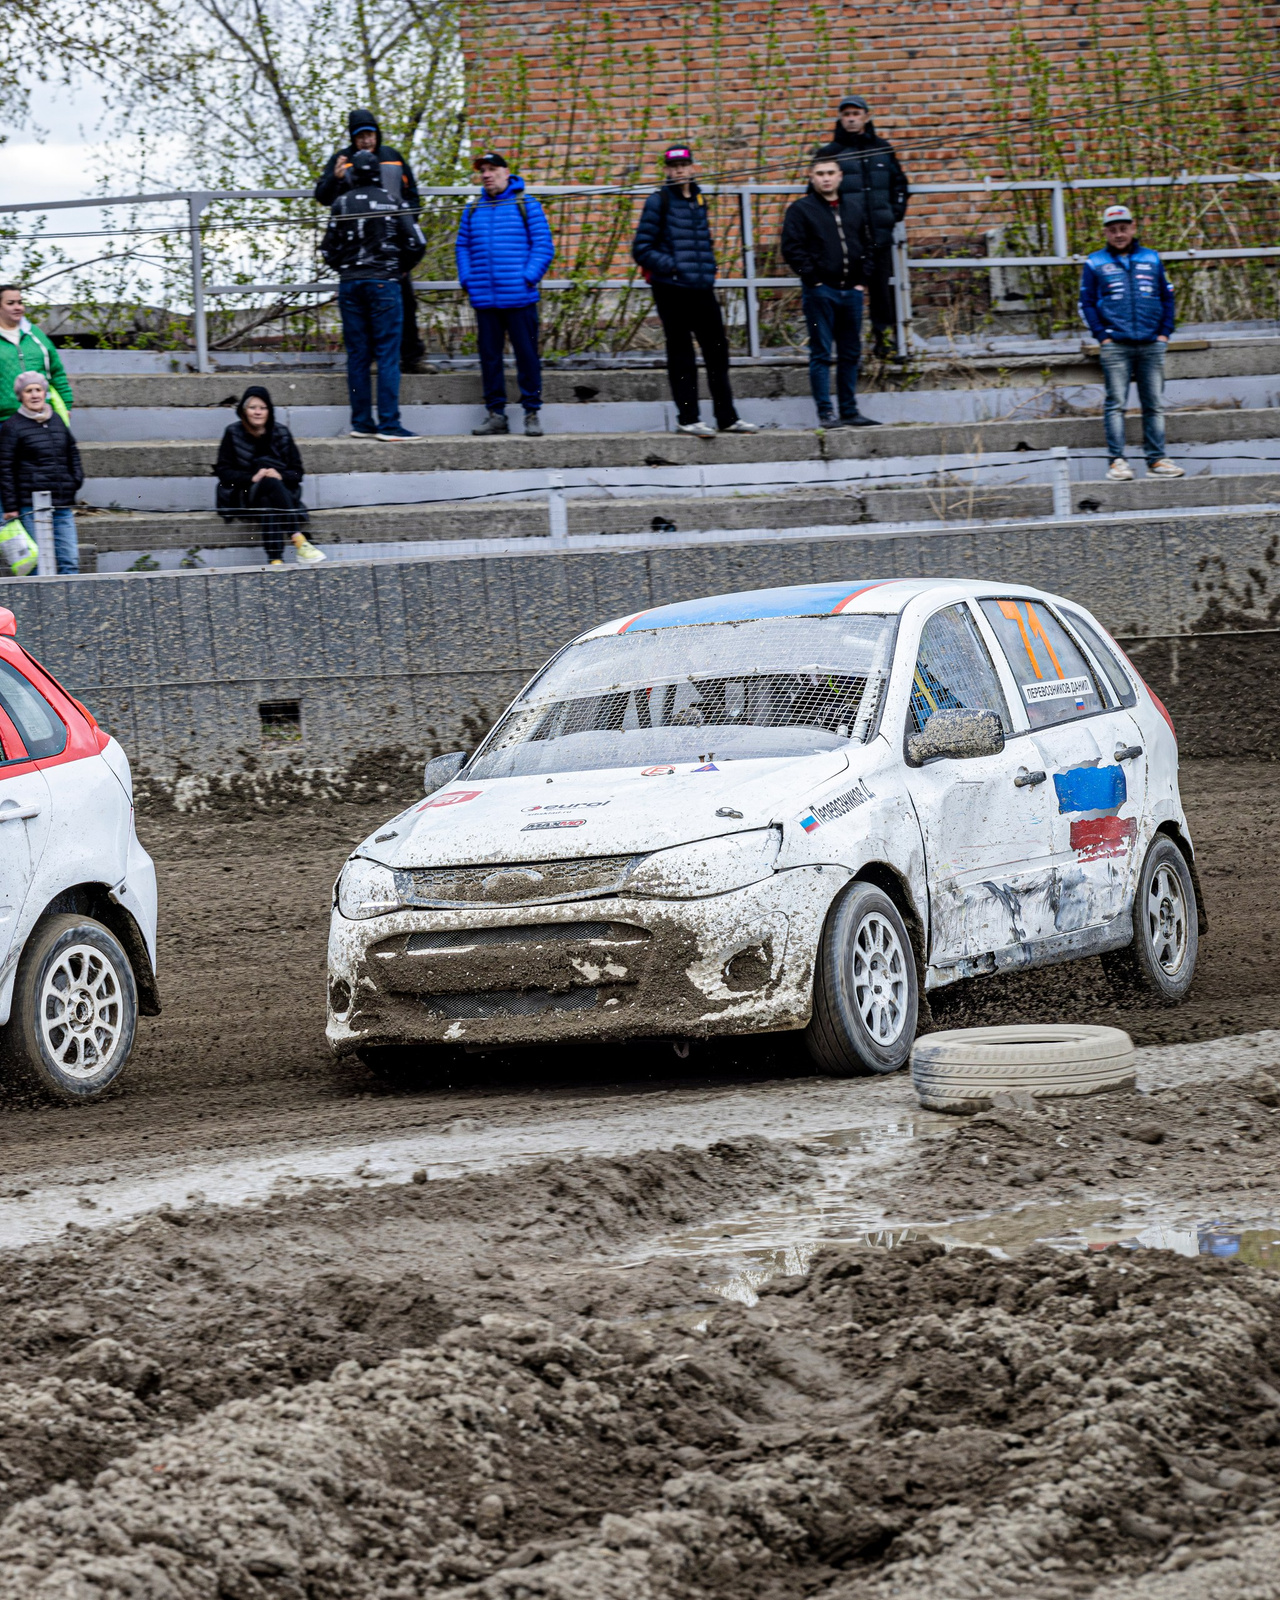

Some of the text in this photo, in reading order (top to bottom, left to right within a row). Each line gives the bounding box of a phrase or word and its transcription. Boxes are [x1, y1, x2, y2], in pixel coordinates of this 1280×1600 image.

[996, 600, 1066, 680] 71
[1026, 679, 1091, 699] ПЕРЕВОЗНИКОВ ДАНИЛ
[542, 800, 611, 810] eurol
[809, 786, 869, 825] Перевозников
